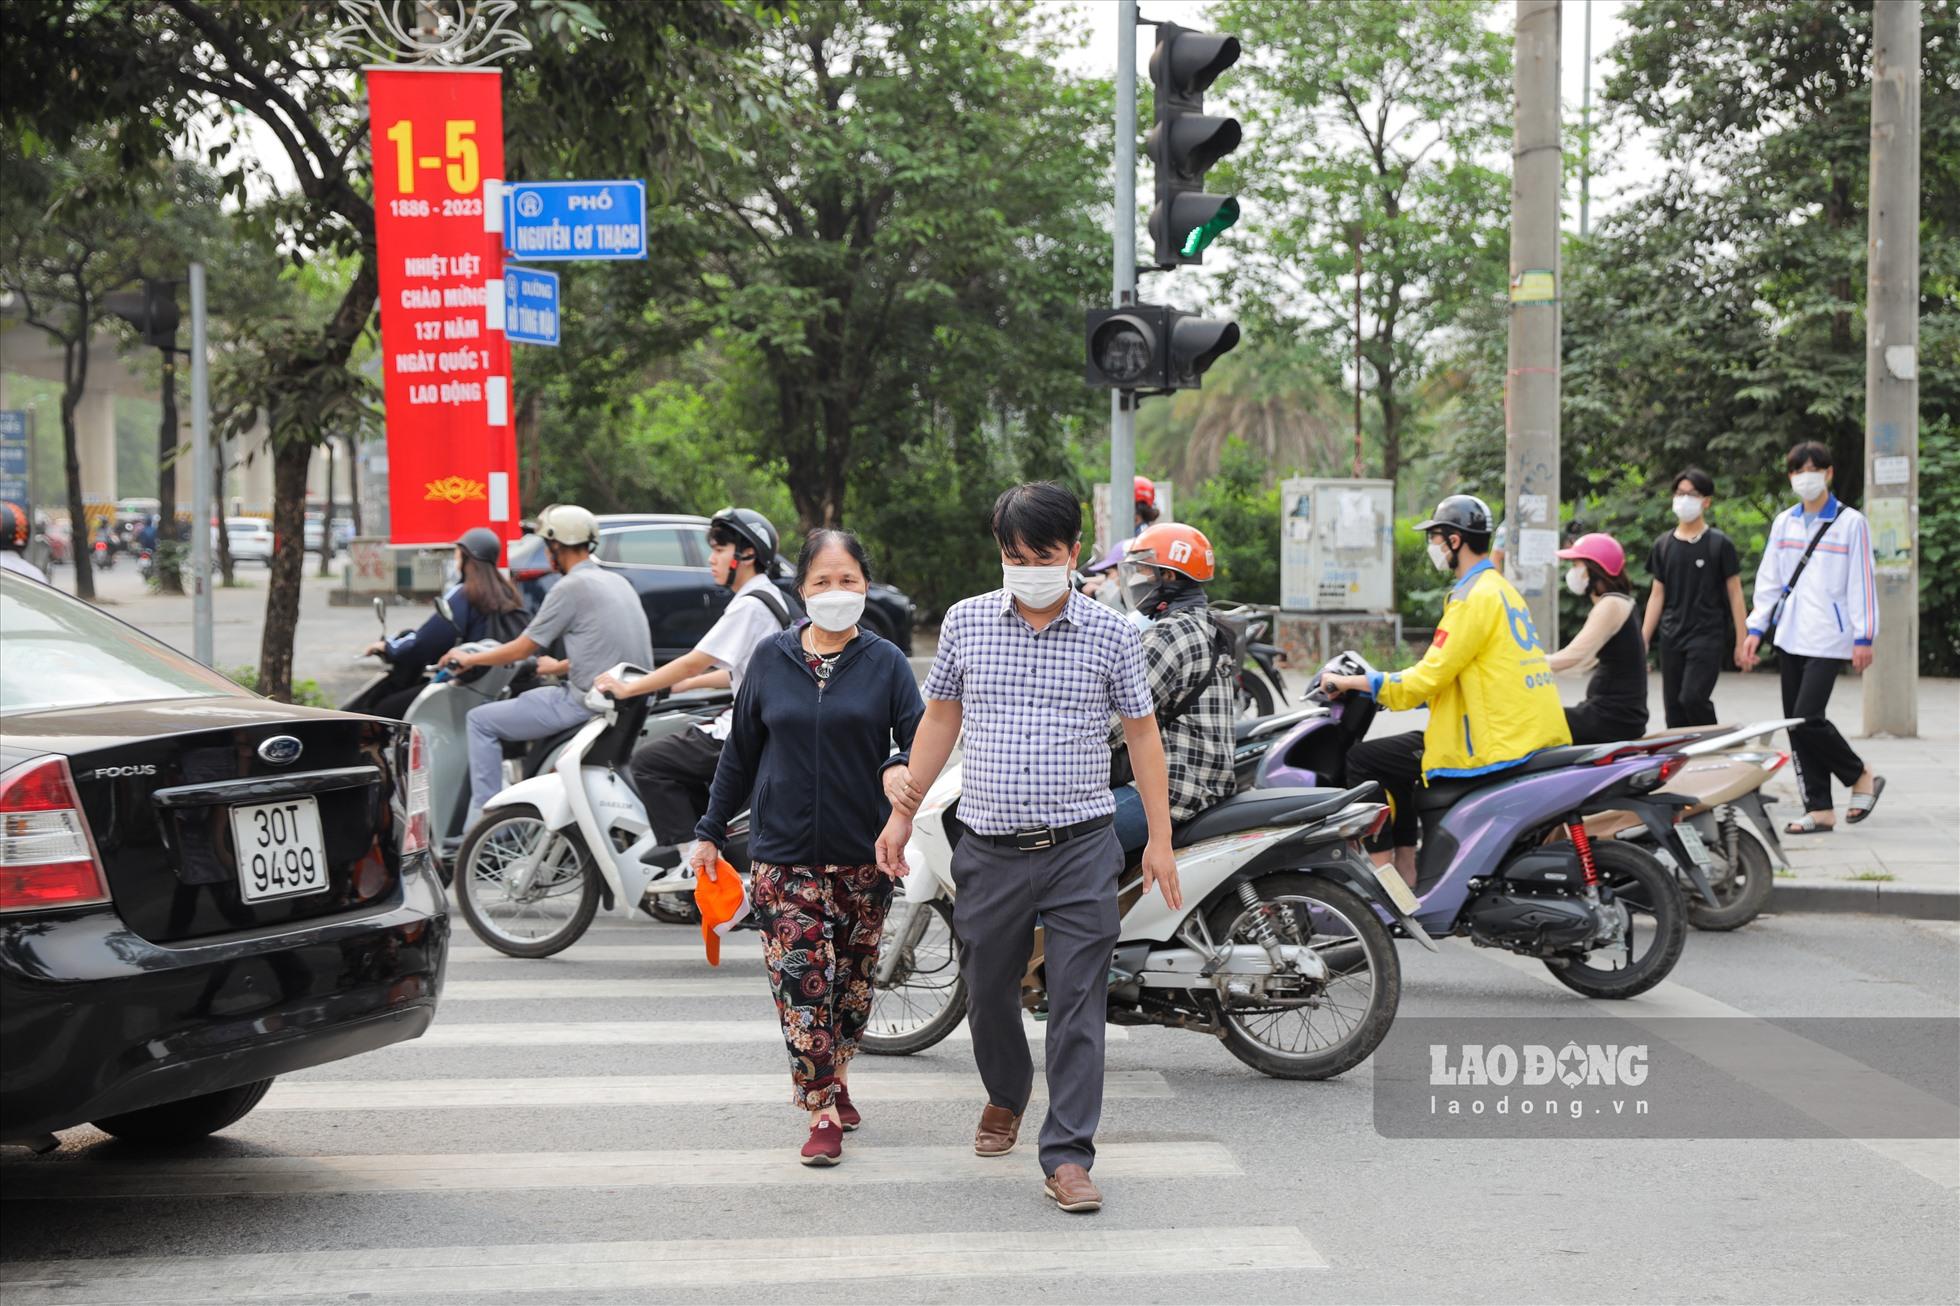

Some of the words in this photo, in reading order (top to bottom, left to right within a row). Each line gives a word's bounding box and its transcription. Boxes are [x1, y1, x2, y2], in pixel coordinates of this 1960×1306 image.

[387, 120, 479, 194] 1-5
[567, 187, 613, 210] PHỐ
[405, 253, 448, 280] NHIỆT
[450, 252, 480, 279] LIỆT
[401, 285, 441, 309] CHÀO
[414, 321, 441, 340] 137
[444, 316, 479, 340] NĂM
[396, 349, 436, 373] NGÀY
[438, 345, 479, 373] QUỐC
[409, 385, 438, 404] LAO
[440, 380, 481, 406] ĐỘNG
[95, 764, 157, 779] FOCUS
[254, 805, 299, 848] 30T
[252, 846, 315, 892] 9499
